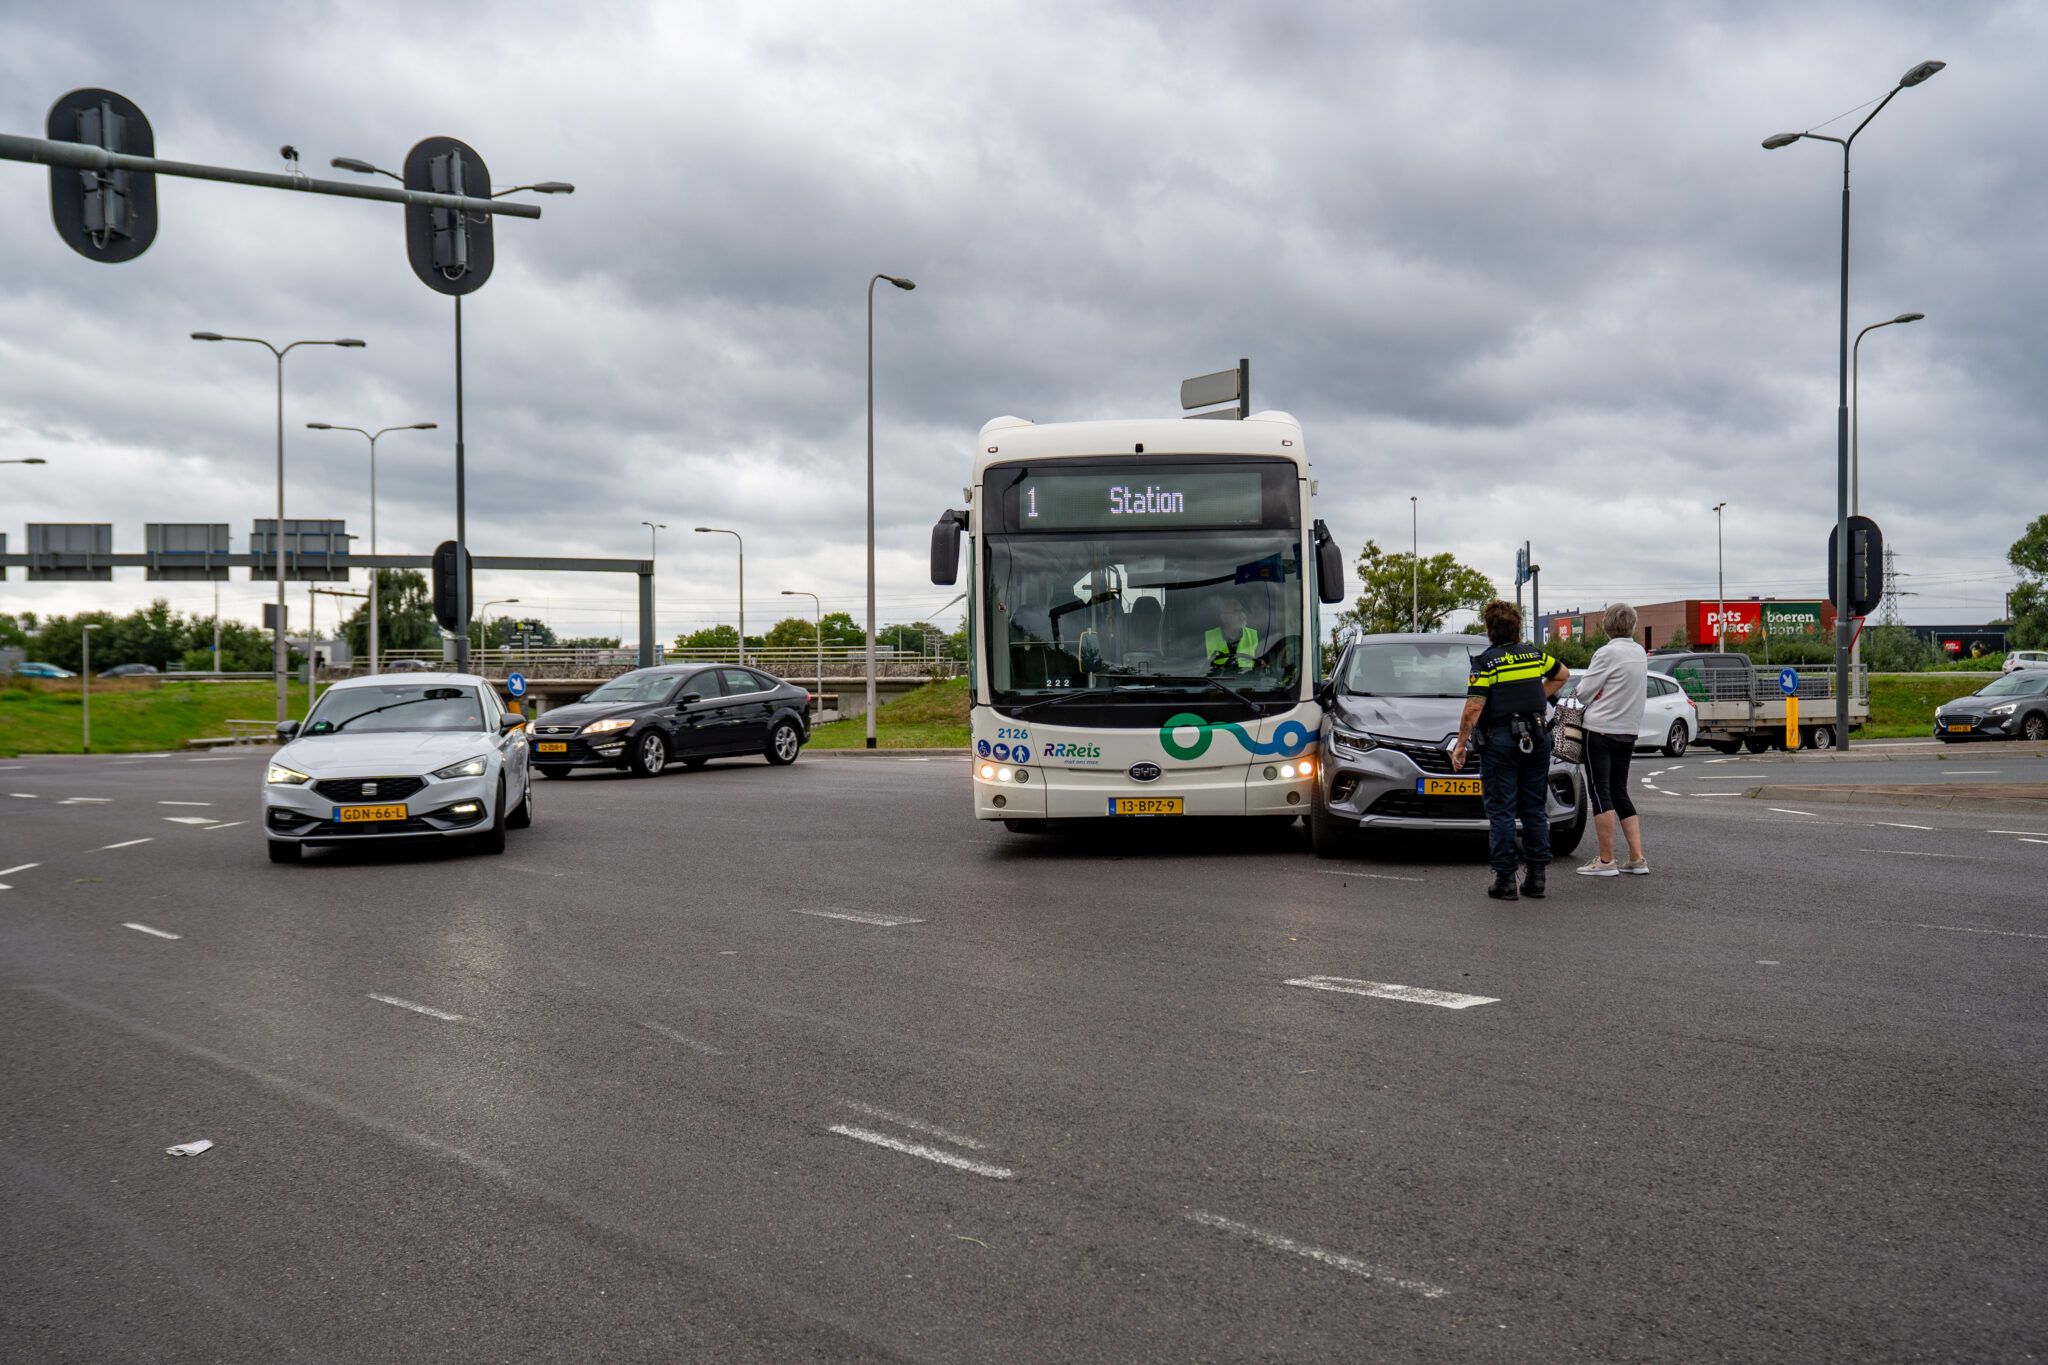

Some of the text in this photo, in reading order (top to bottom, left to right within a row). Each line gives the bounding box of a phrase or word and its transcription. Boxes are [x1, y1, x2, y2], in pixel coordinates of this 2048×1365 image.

[1028, 486, 1184, 517] 1 Station
[1707, 610, 1742, 625] pets
[1766, 611, 1815, 622] boeren
[1713, 622, 1753, 636] place
[998, 728, 1029, 739] 2126
[1044, 742, 1101, 758] RRReis
[1132, 767, 1158, 777] BYD
[1431, 781, 1481, 793] P-216-B
[1121, 800, 1175, 812] 13-BPZ-9
[343, 807, 404, 820] GDN-66-L
